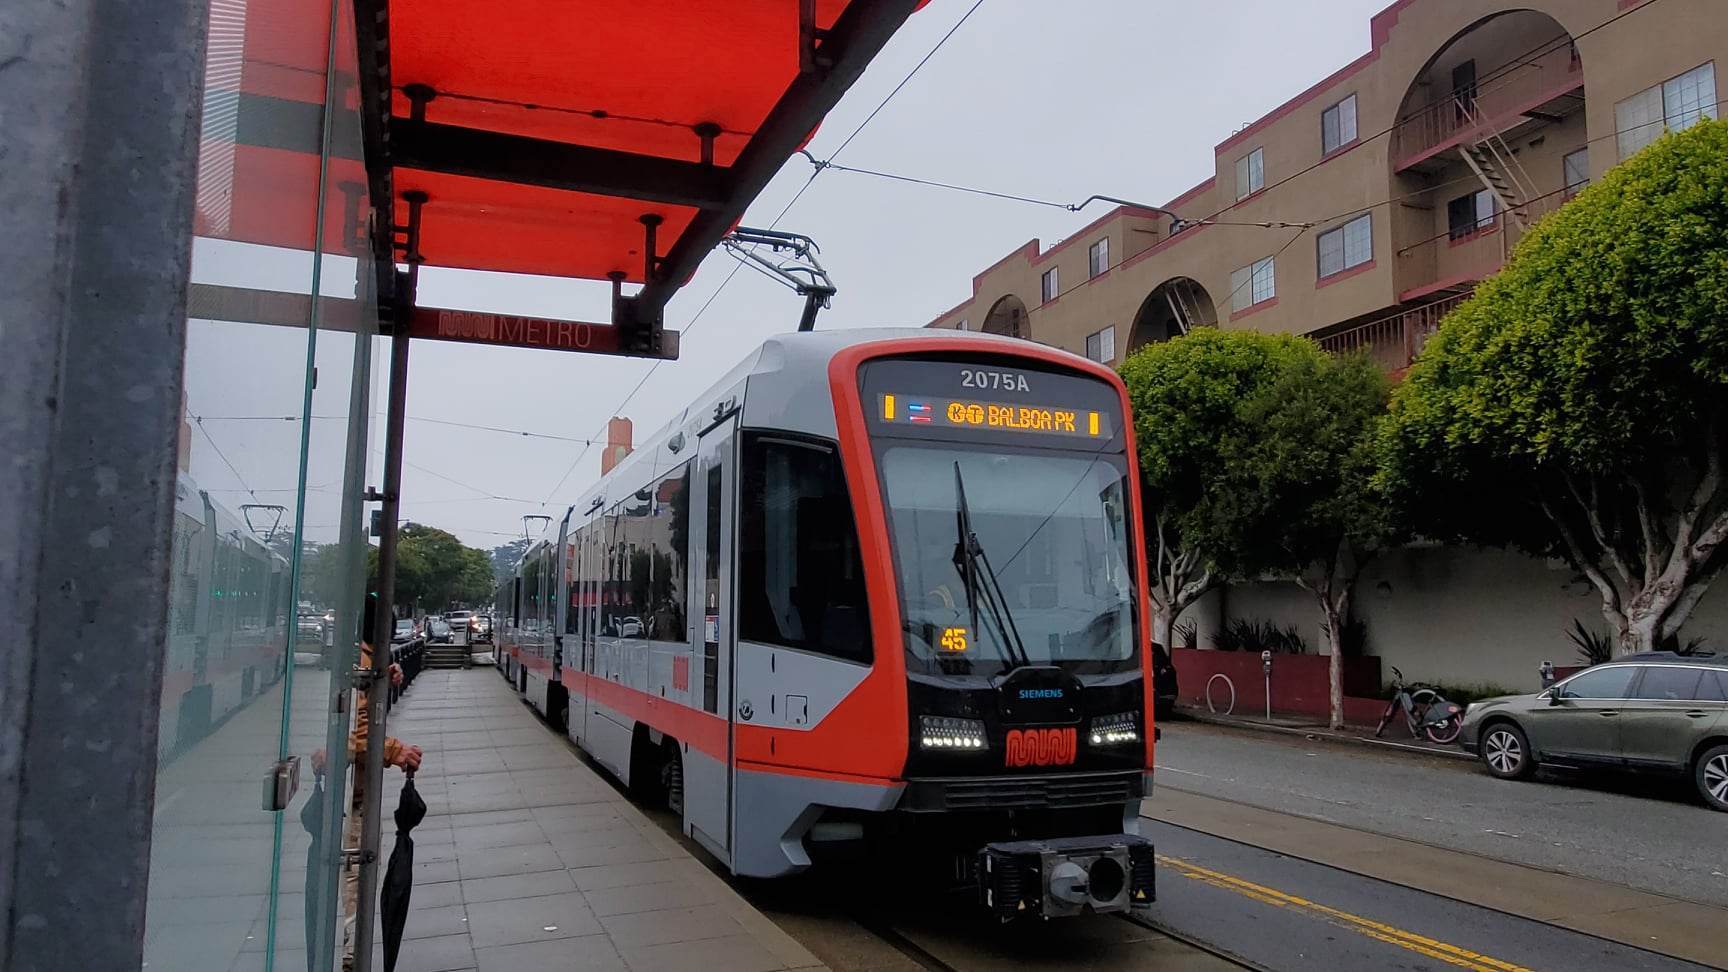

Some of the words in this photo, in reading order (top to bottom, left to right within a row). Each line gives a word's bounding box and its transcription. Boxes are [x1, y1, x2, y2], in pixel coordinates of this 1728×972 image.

[499, 317, 592, 348] METRO
[961, 369, 1030, 392] 2075A
[988, 405, 1051, 430] BALBOA
[1054, 411, 1076, 432] PK
[941, 628, 967, 651] 45
[1019, 688, 1064, 699] SIEMENS
